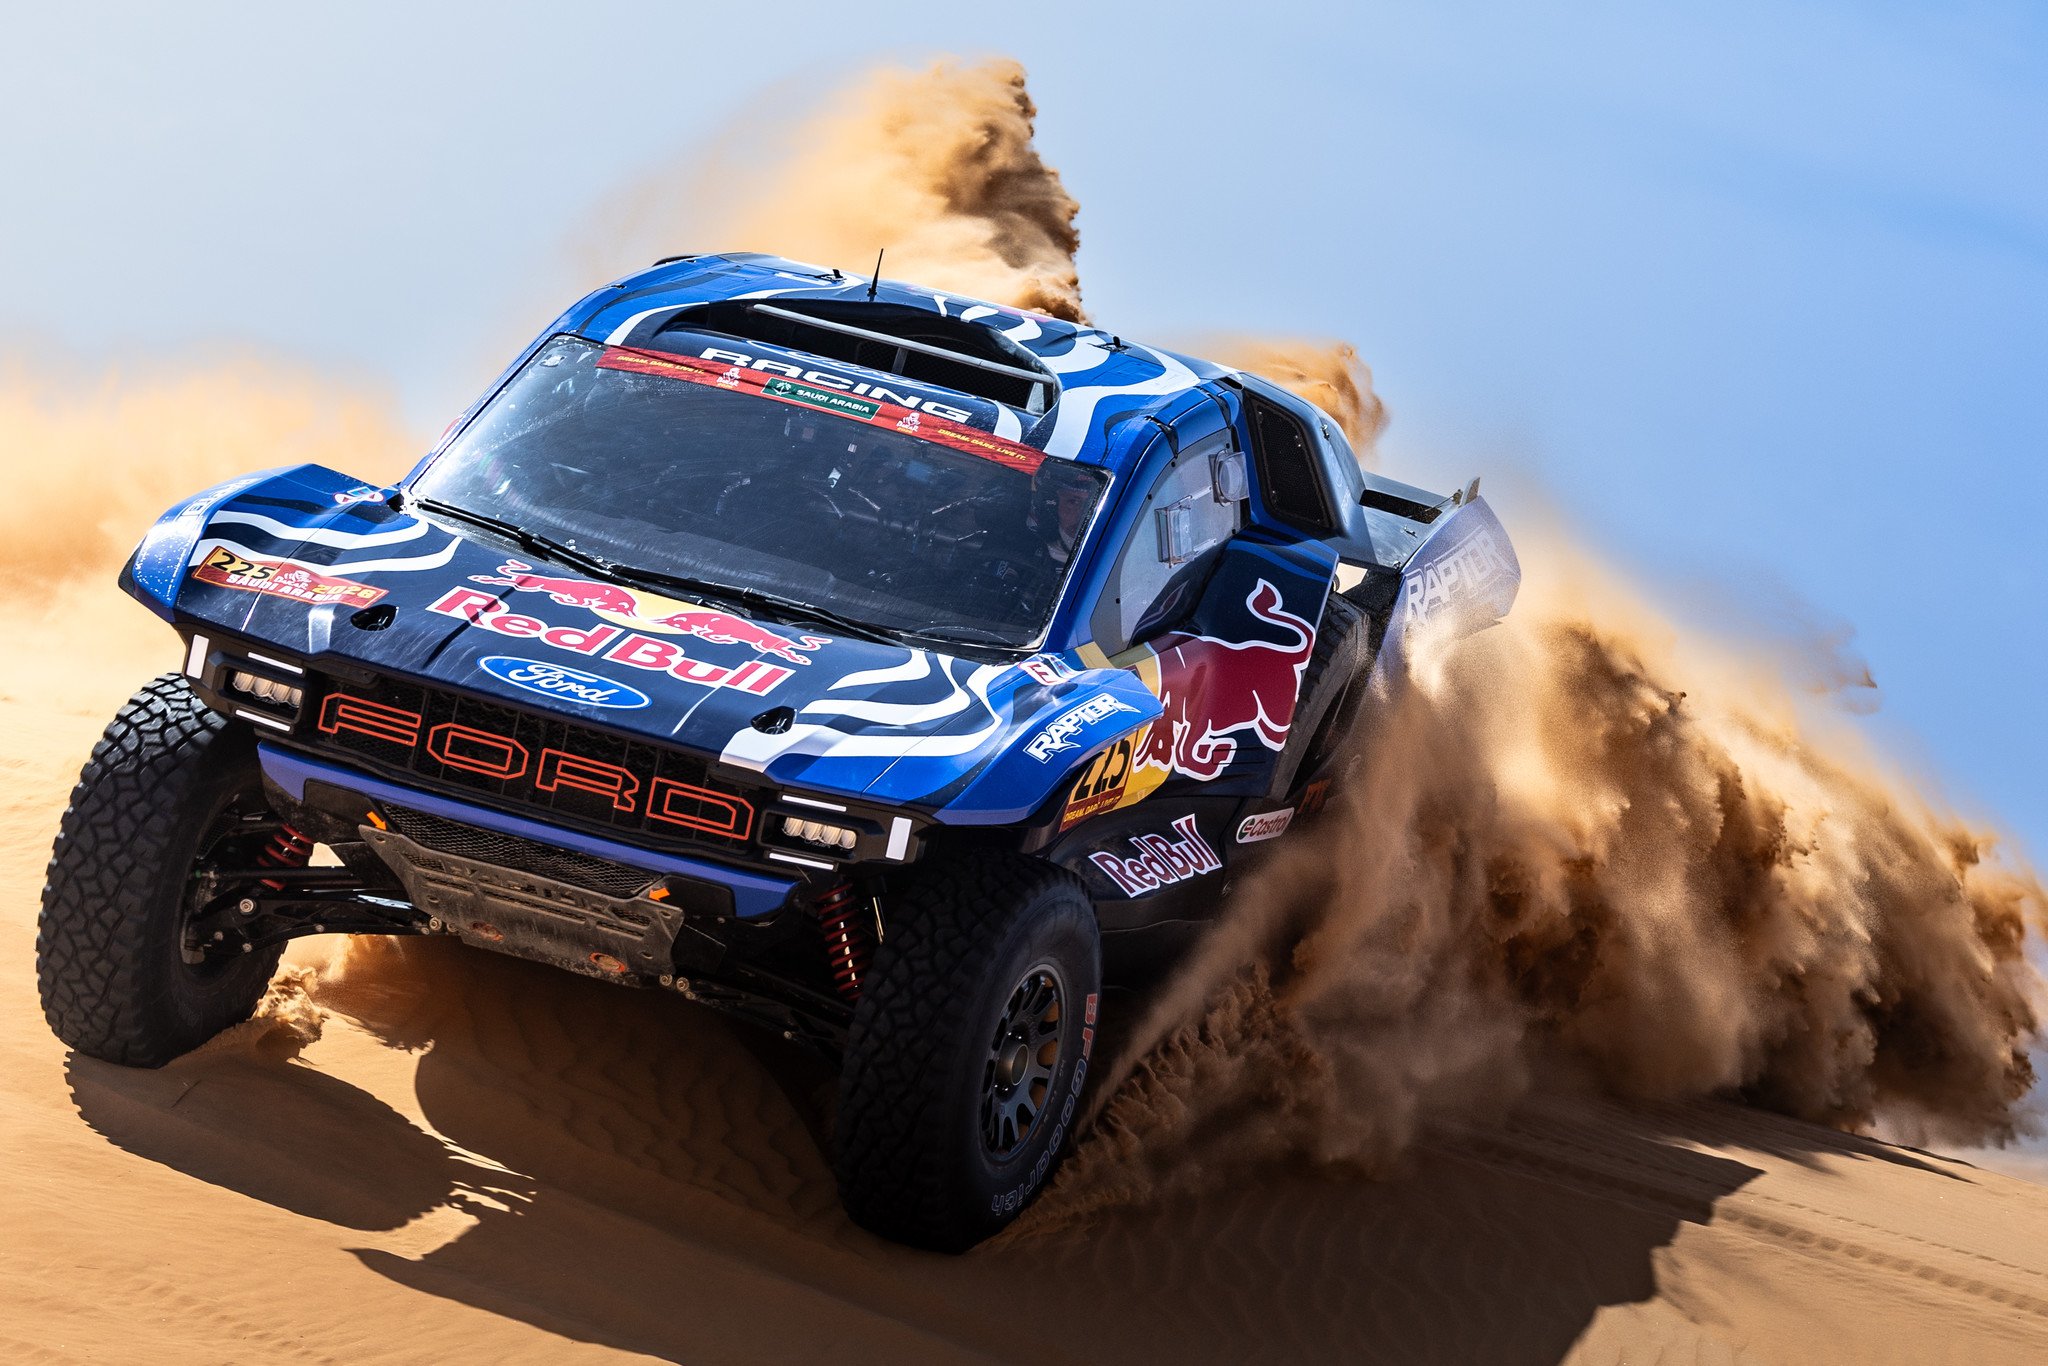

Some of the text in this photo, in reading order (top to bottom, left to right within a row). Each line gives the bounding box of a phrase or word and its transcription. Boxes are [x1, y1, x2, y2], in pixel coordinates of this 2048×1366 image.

[699, 347, 973, 424] RACING
[796, 389, 871, 413] SAUDI ARABIA
[937, 428, 970, 442] DREAM.
[971, 439, 996, 450] DARE.
[211, 552, 277, 579] 225
[225, 573, 279, 591] SAUDI
[425, 585, 797, 697] Red Bull
[508, 663, 620, 704] Ford
[1022, 692, 1142, 765] RAPTOR
[318, 693, 755, 841] FORD
[1250, 811, 1293, 837] Castrol
[1088, 813, 1223, 899] Red Bull
